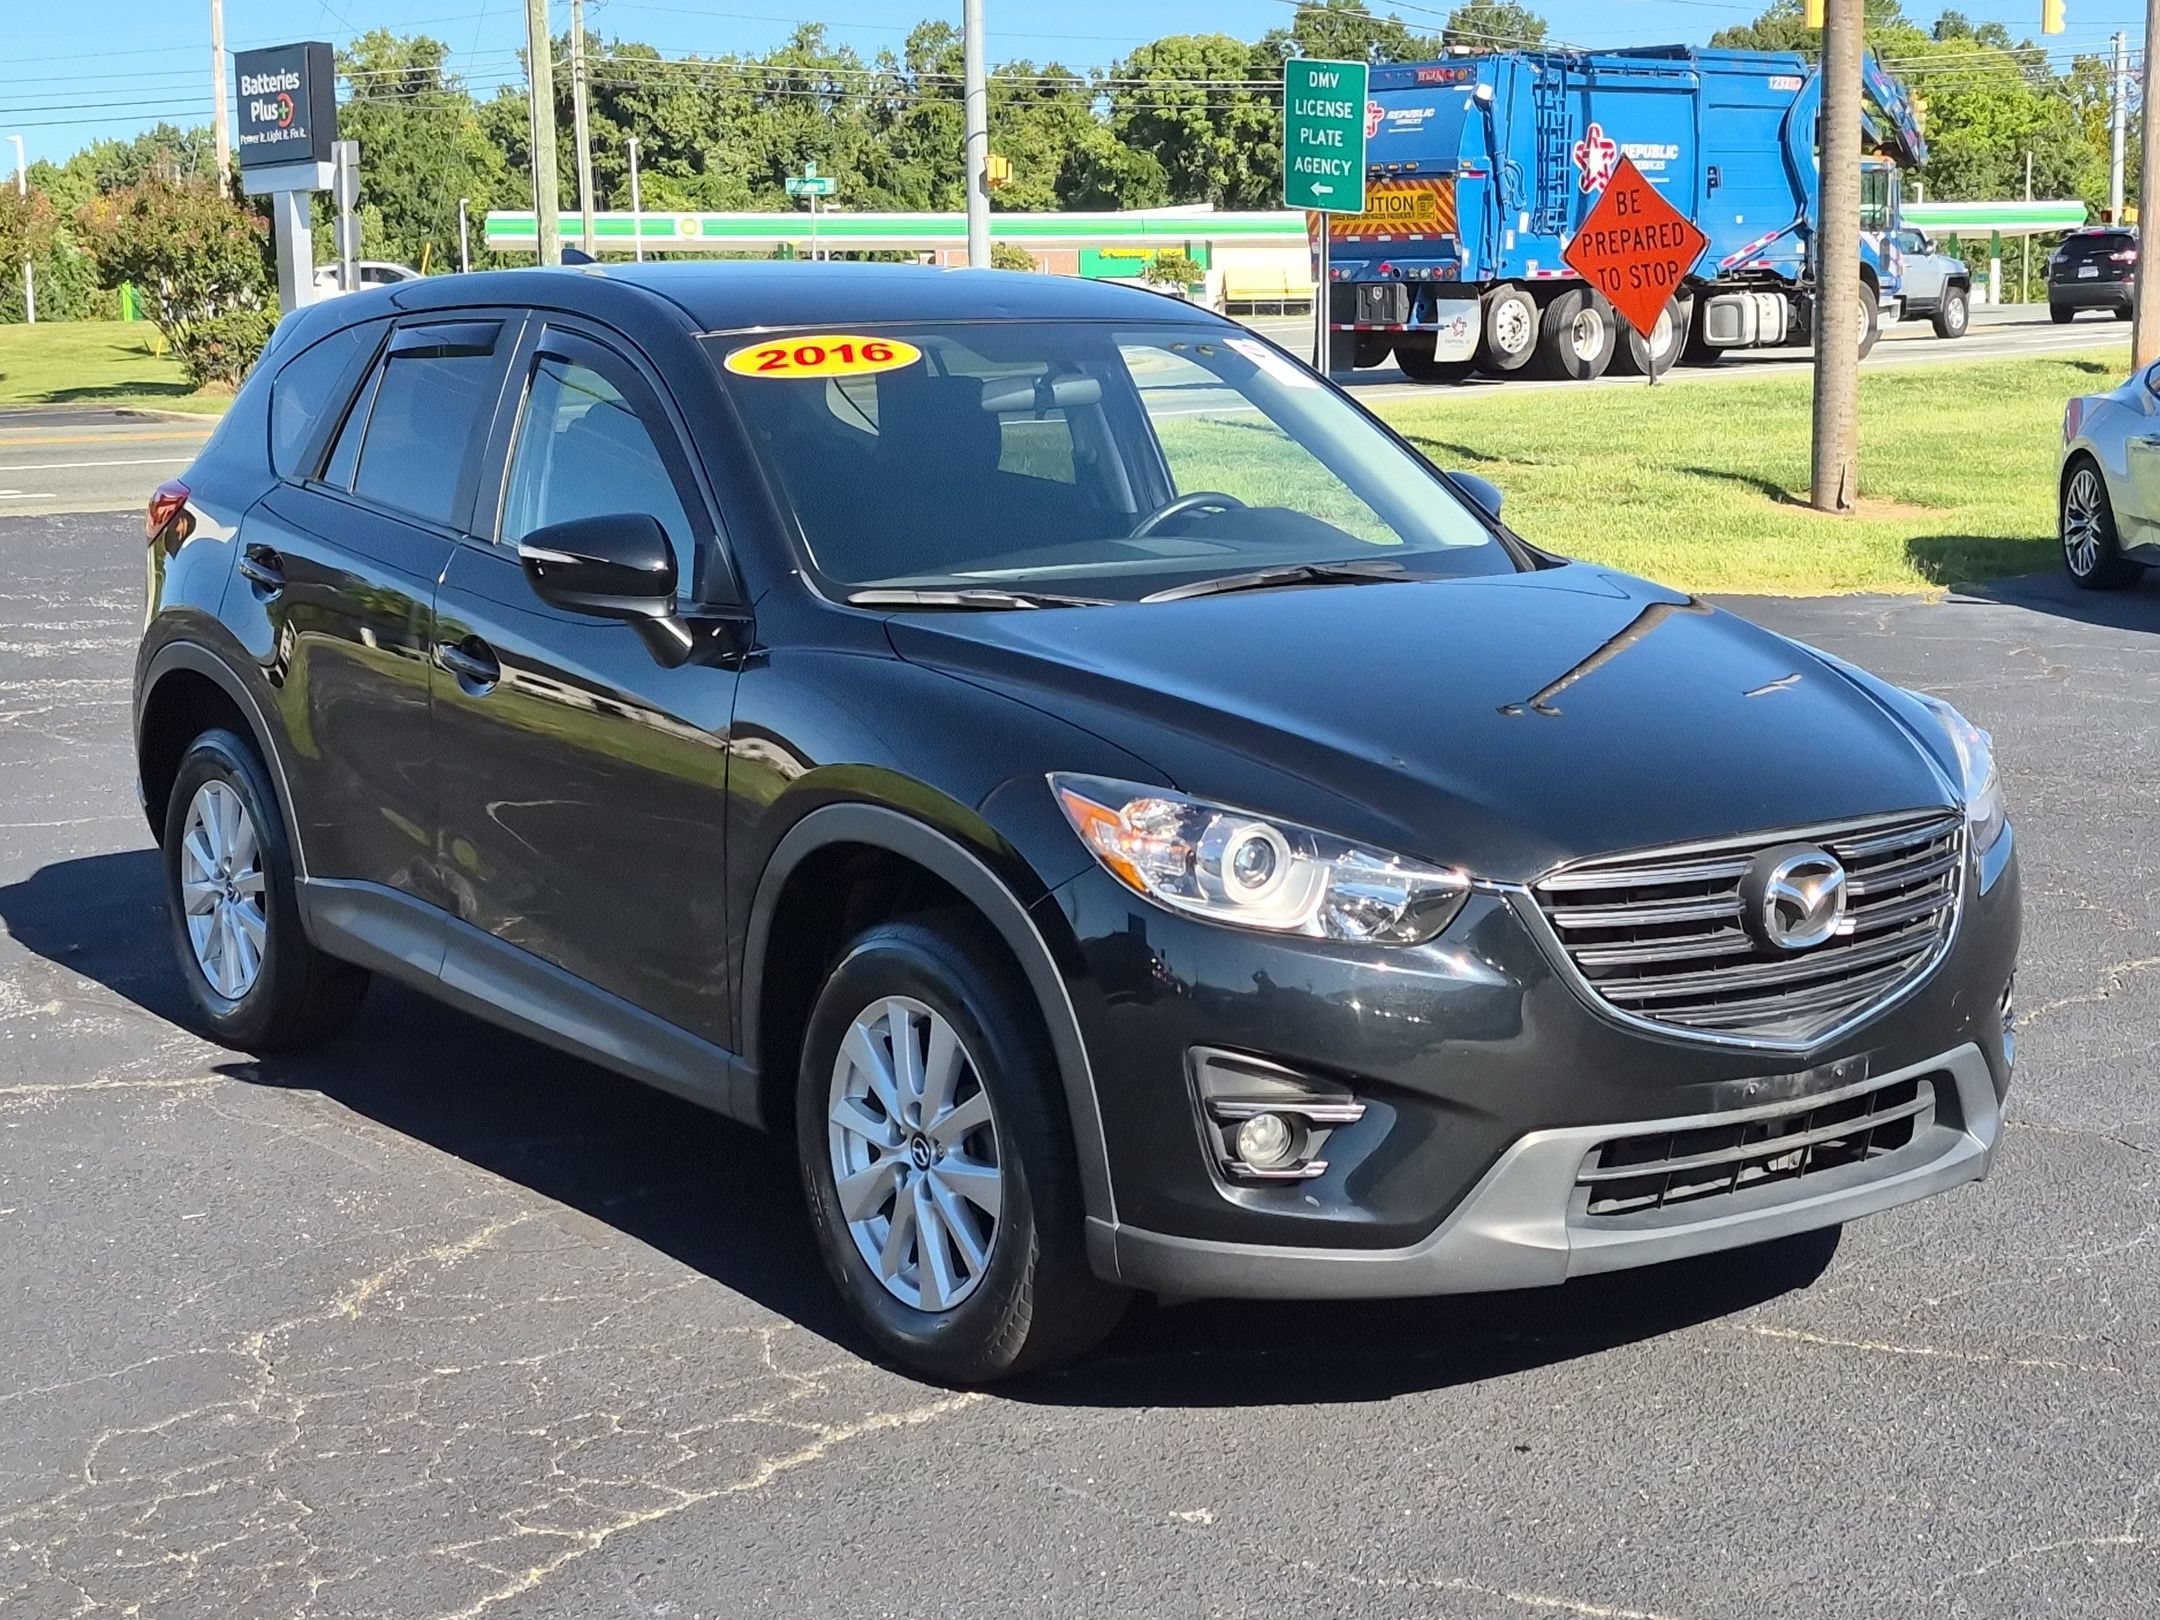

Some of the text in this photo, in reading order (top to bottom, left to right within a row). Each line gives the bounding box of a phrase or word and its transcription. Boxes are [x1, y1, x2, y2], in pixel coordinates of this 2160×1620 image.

[241, 67, 300, 97] Batteries
[1309, 71, 1340, 89] DMV
[1295, 98, 1354, 119] LICENSE
[1386, 109, 1435, 120] REPUBLIC
[1300, 127, 1344, 147] PLATE
[1294, 156, 1352, 176] AGENCY
[1365, 195, 1415, 213] UTION
[1616, 189, 1641, 216] BE
[1582, 222, 1684, 257] PREPARED
[1597, 260, 1679, 292] TO STOP
[756, 343, 894, 371] 2016
